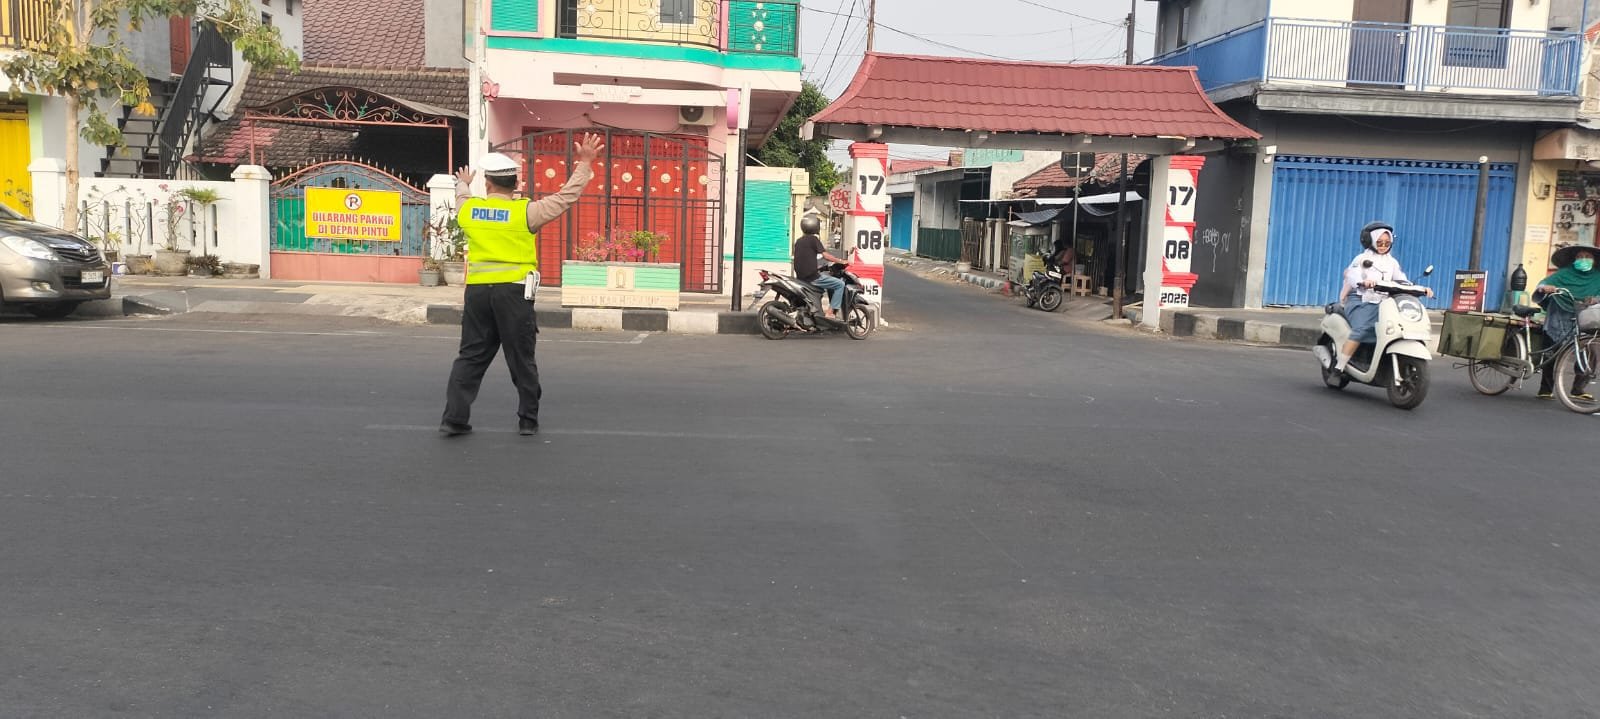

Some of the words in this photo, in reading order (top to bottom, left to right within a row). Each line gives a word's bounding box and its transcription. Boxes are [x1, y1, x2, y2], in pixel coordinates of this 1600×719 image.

[859, 175, 885, 195] 17
[1169, 186, 1194, 206] 17
[312, 212, 358, 224] DILARANG
[360, 214, 394, 225] PARKIR
[471, 207, 509, 222] POLISI
[318, 224, 328, 234] DI
[331, 225, 359, 235] DEPAN
[361, 226, 389, 237] PINTU
[857, 230, 882, 250] 08
[1165, 240, 1190, 259] 08
[1160, 292, 1188, 304] 2026
